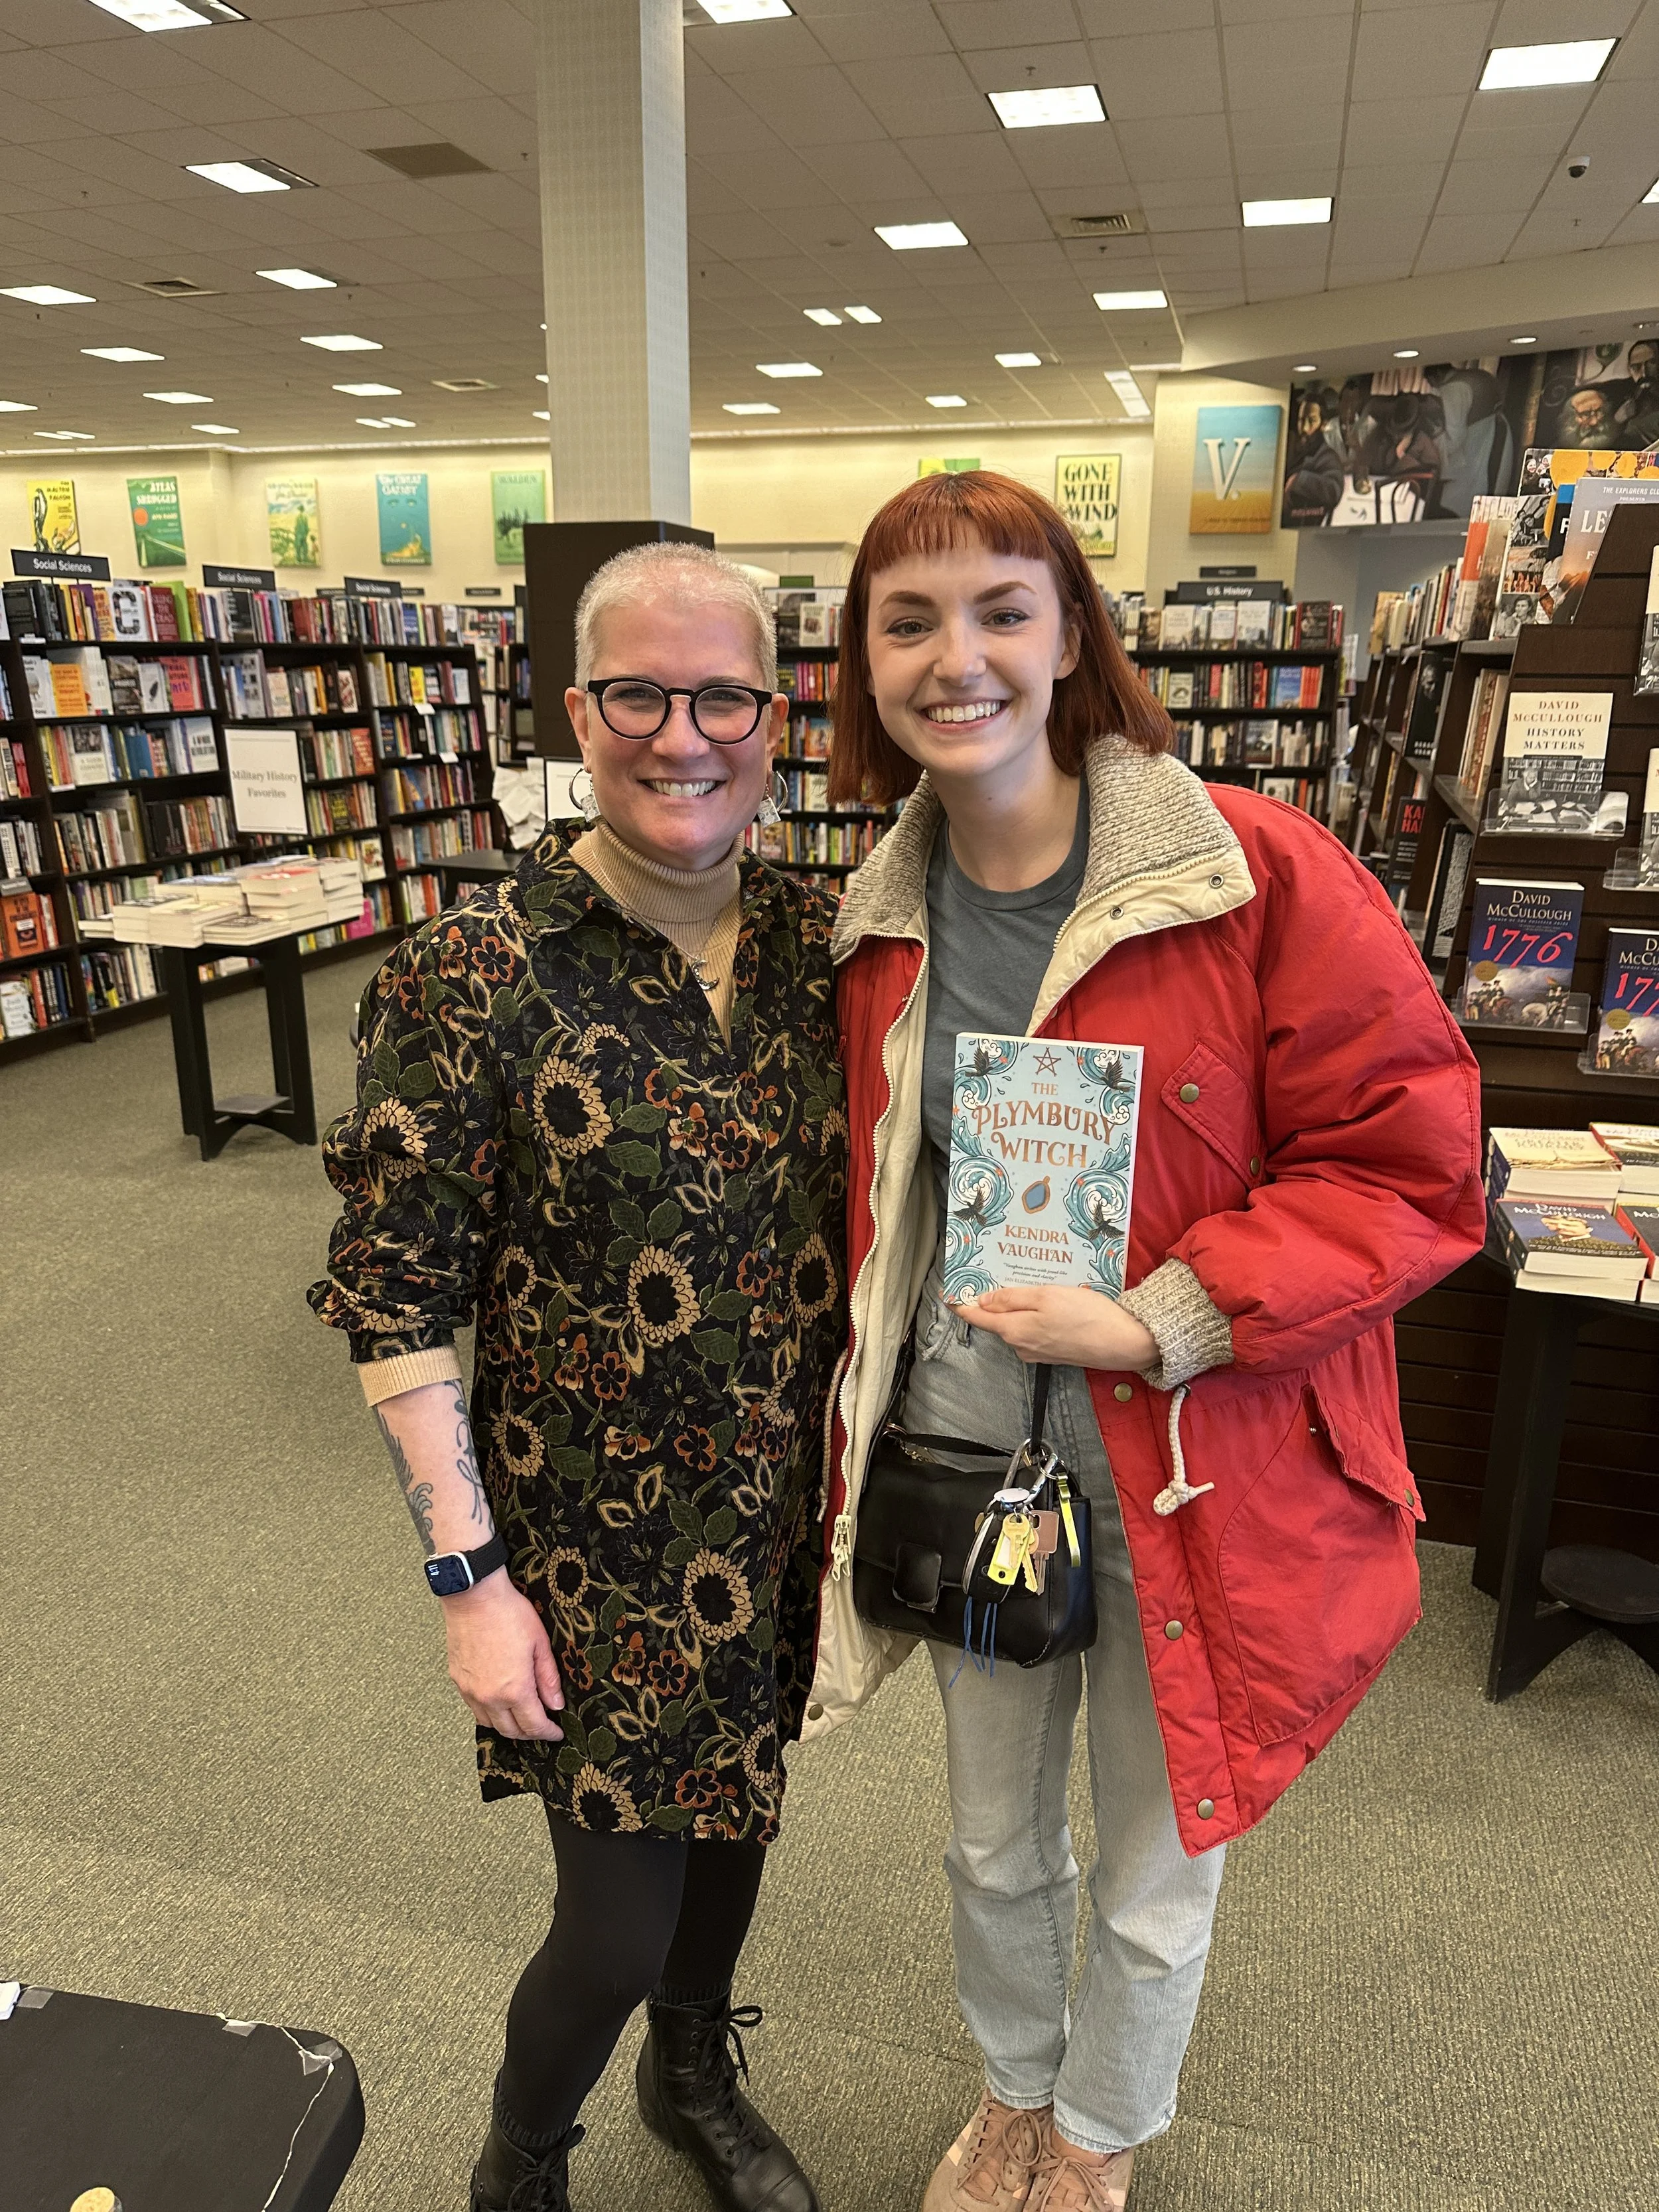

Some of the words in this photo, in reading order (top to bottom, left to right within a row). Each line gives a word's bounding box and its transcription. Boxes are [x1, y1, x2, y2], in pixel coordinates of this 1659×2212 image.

[1064, 463, 1113, 482] GONE
[150, 481, 176, 492] ATLAS
[1064, 483, 1110, 502] WITH
[1066, 503, 1118, 522] WIND
[33, 557, 58, 569] Social
[58, 560, 92, 573] Sciences
[217, 571, 236, 583] Social
[236, 573, 263, 585] Sciences
[1206, 585, 1221, 596] U.S.
[1223, 586, 1254, 597] History
[1539, 701, 1579, 709] DAVID
[1527, 727, 1585, 737] HISTORY
[1523, 741, 1585, 750] MATTERS
[232, 770, 265, 783] Military
[267, 771, 299, 784] History
[247, 787, 287, 799] Favorites
[1512, 890, 1551, 905] DAVID
[1482, 924, 1573, 969] 1776
[1031, 1082, 1058, 1095] THE
[972, 1100, 1119, 1145] PLYMBURY
[990, 1132, 1088, 1169] WITCH
[1535, 1203, 1577, 1213] DAVID
[1005, 1224, 1069, 1244] KENDRA
[997, 1242, 1074, 1264] VAUGHAN
[428, 1564, 440, 1576] 4:11
